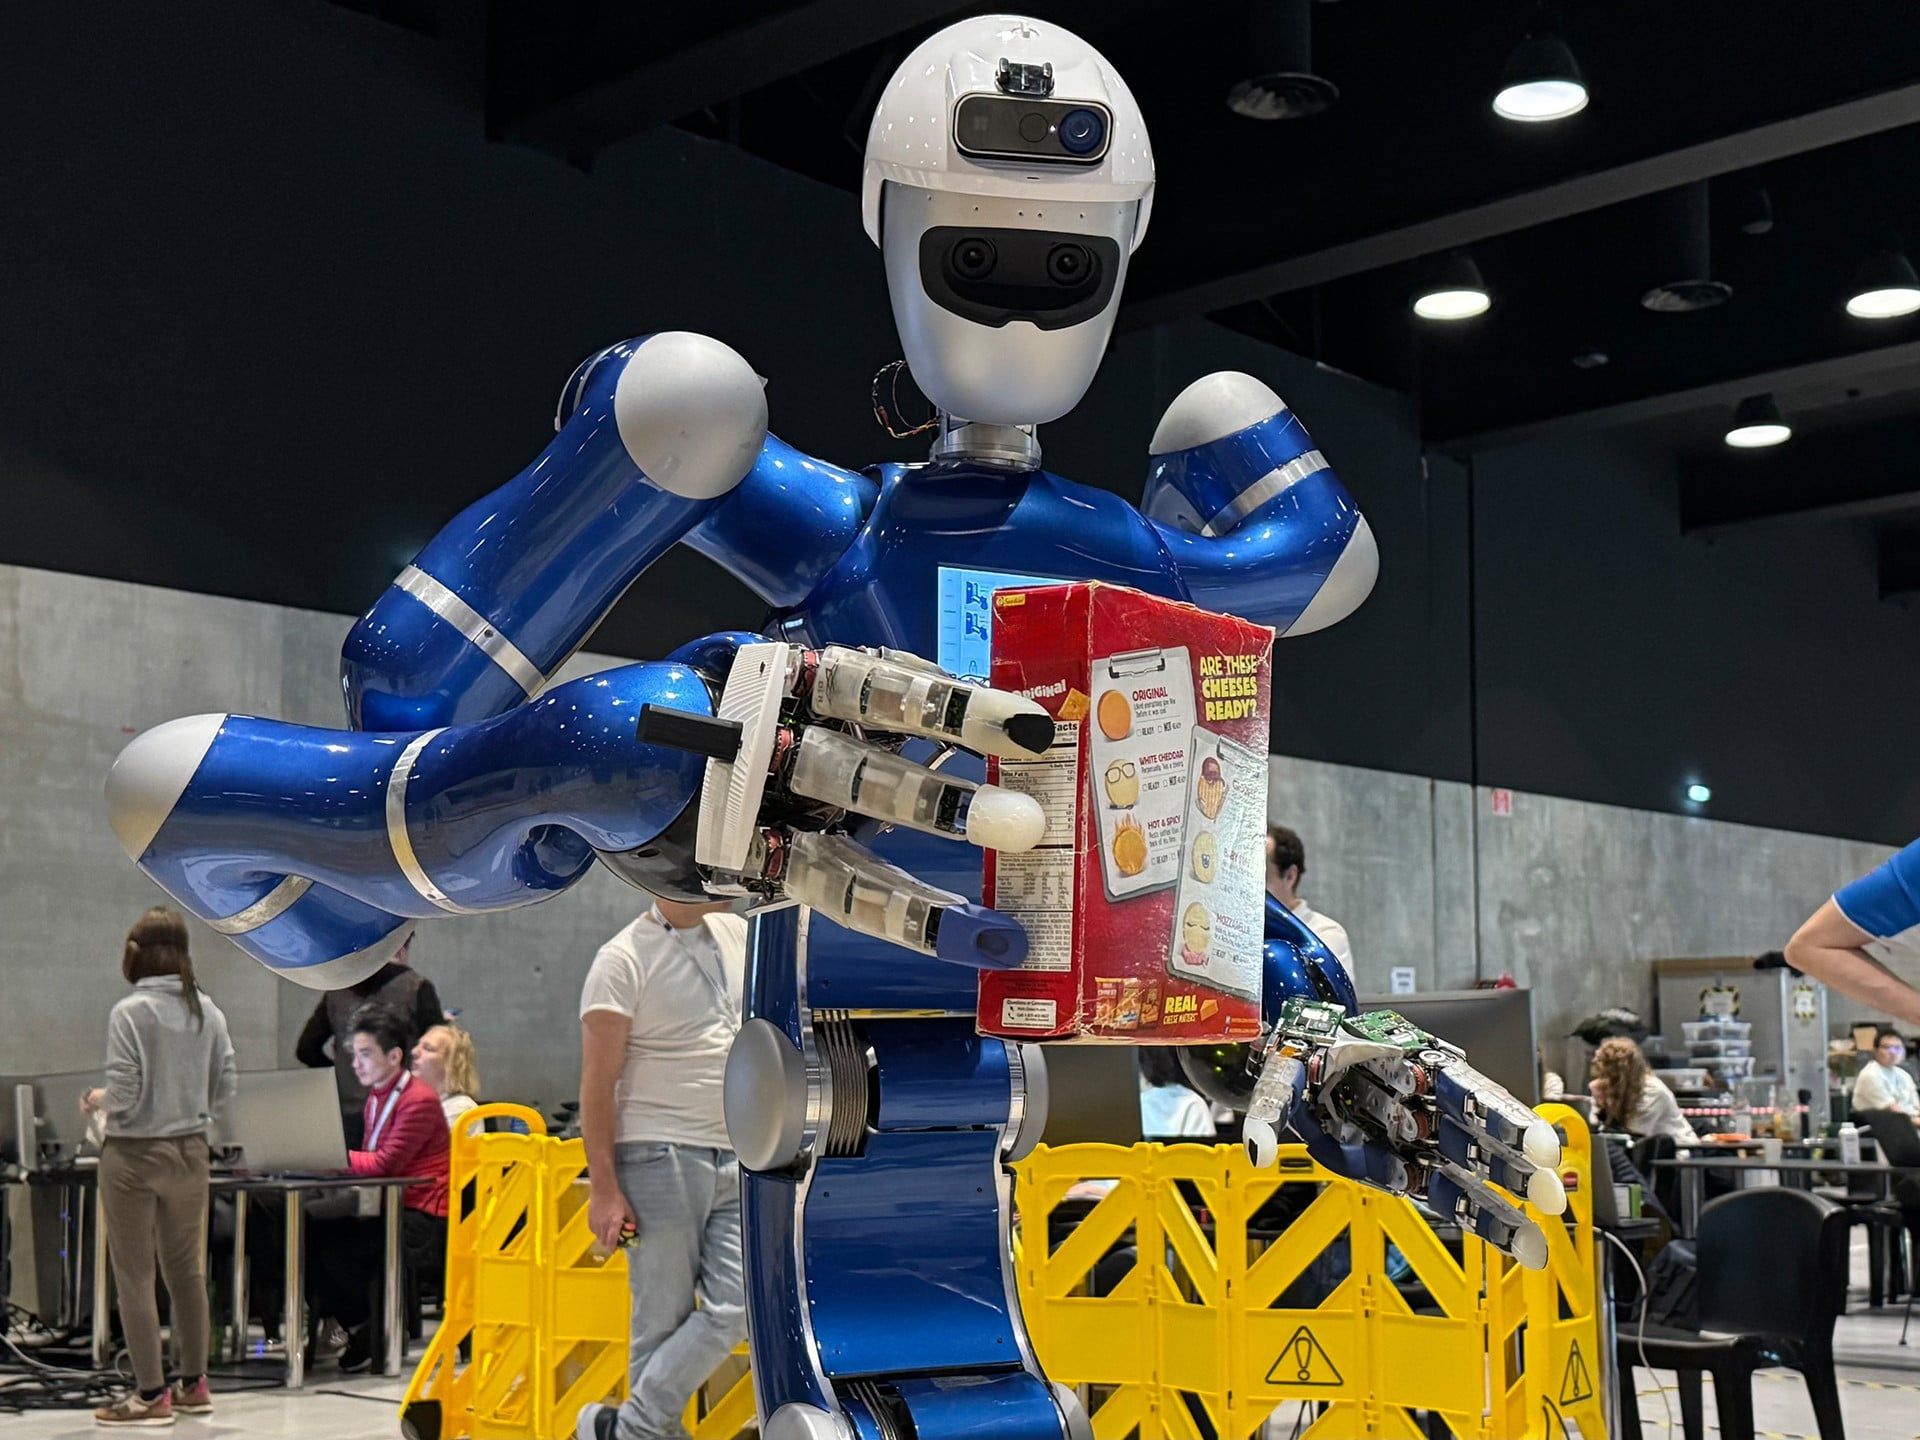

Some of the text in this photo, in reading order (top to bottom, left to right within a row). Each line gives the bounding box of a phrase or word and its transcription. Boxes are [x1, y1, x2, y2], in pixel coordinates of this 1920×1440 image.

[1200, 654, 1258, 677] ARE THESE
[1132, 686, 1168, 702] ORIGINAL
[1202, 676, 1258, 699] CHEESES
[1205, 698, 1258, 721] READY?
[1139, 750, 1184, 766] WHITE CHEDDAR
[1147, 815, 1181, 830] HOT & SPICY
[1165, 995, 1197, 1013] REAL
